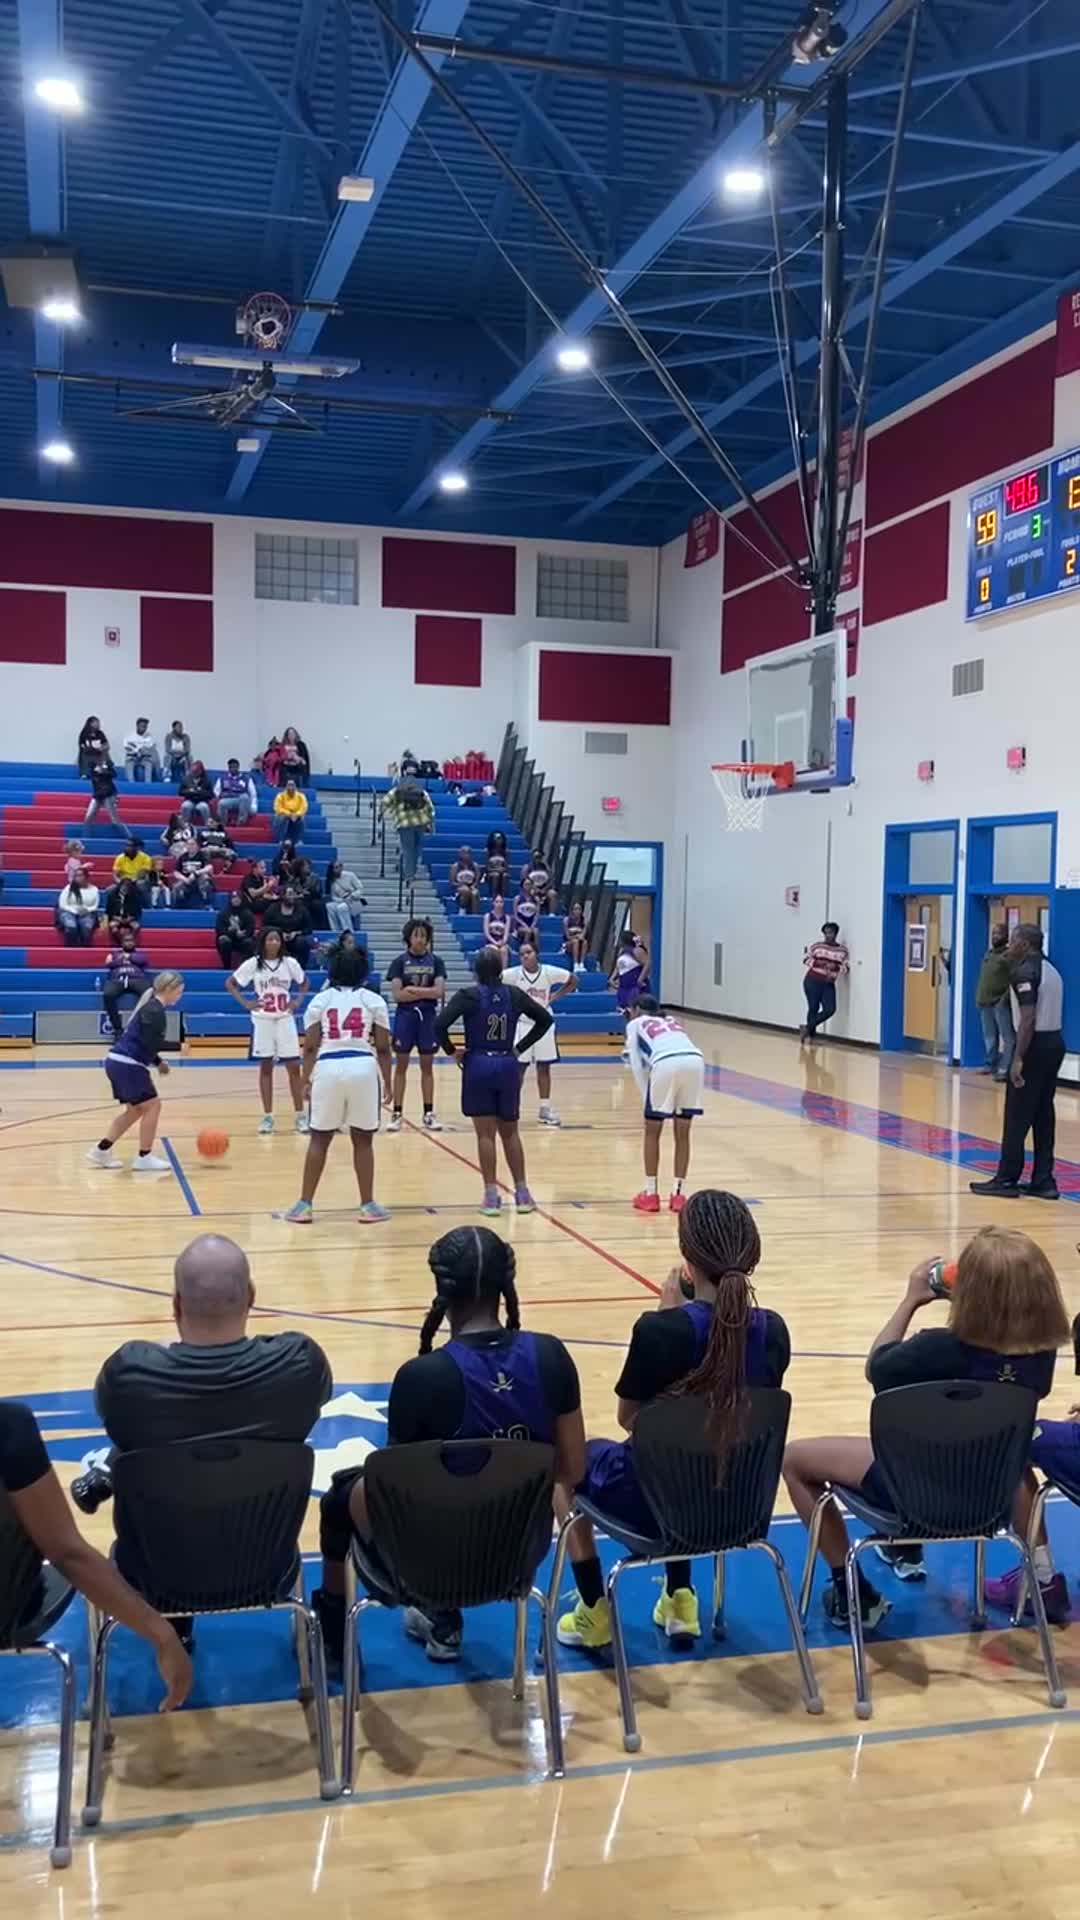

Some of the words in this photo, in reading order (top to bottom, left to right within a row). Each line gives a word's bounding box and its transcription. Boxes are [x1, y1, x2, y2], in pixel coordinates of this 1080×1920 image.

[973, 489, 1000, 512] GUEST
[977, 509, 996, 544] 59
[1003, 524, 1029, 542] PERIOD
[1032, 514, 1041, 538] 3
[1066, 549, 1076, 574] 2
[980, 577, 990, 601] 0
[263, 992, 288, 1013] 20
[325, 1007, 365, 1040] 14
[486, 1013, 508, 1041] 21
